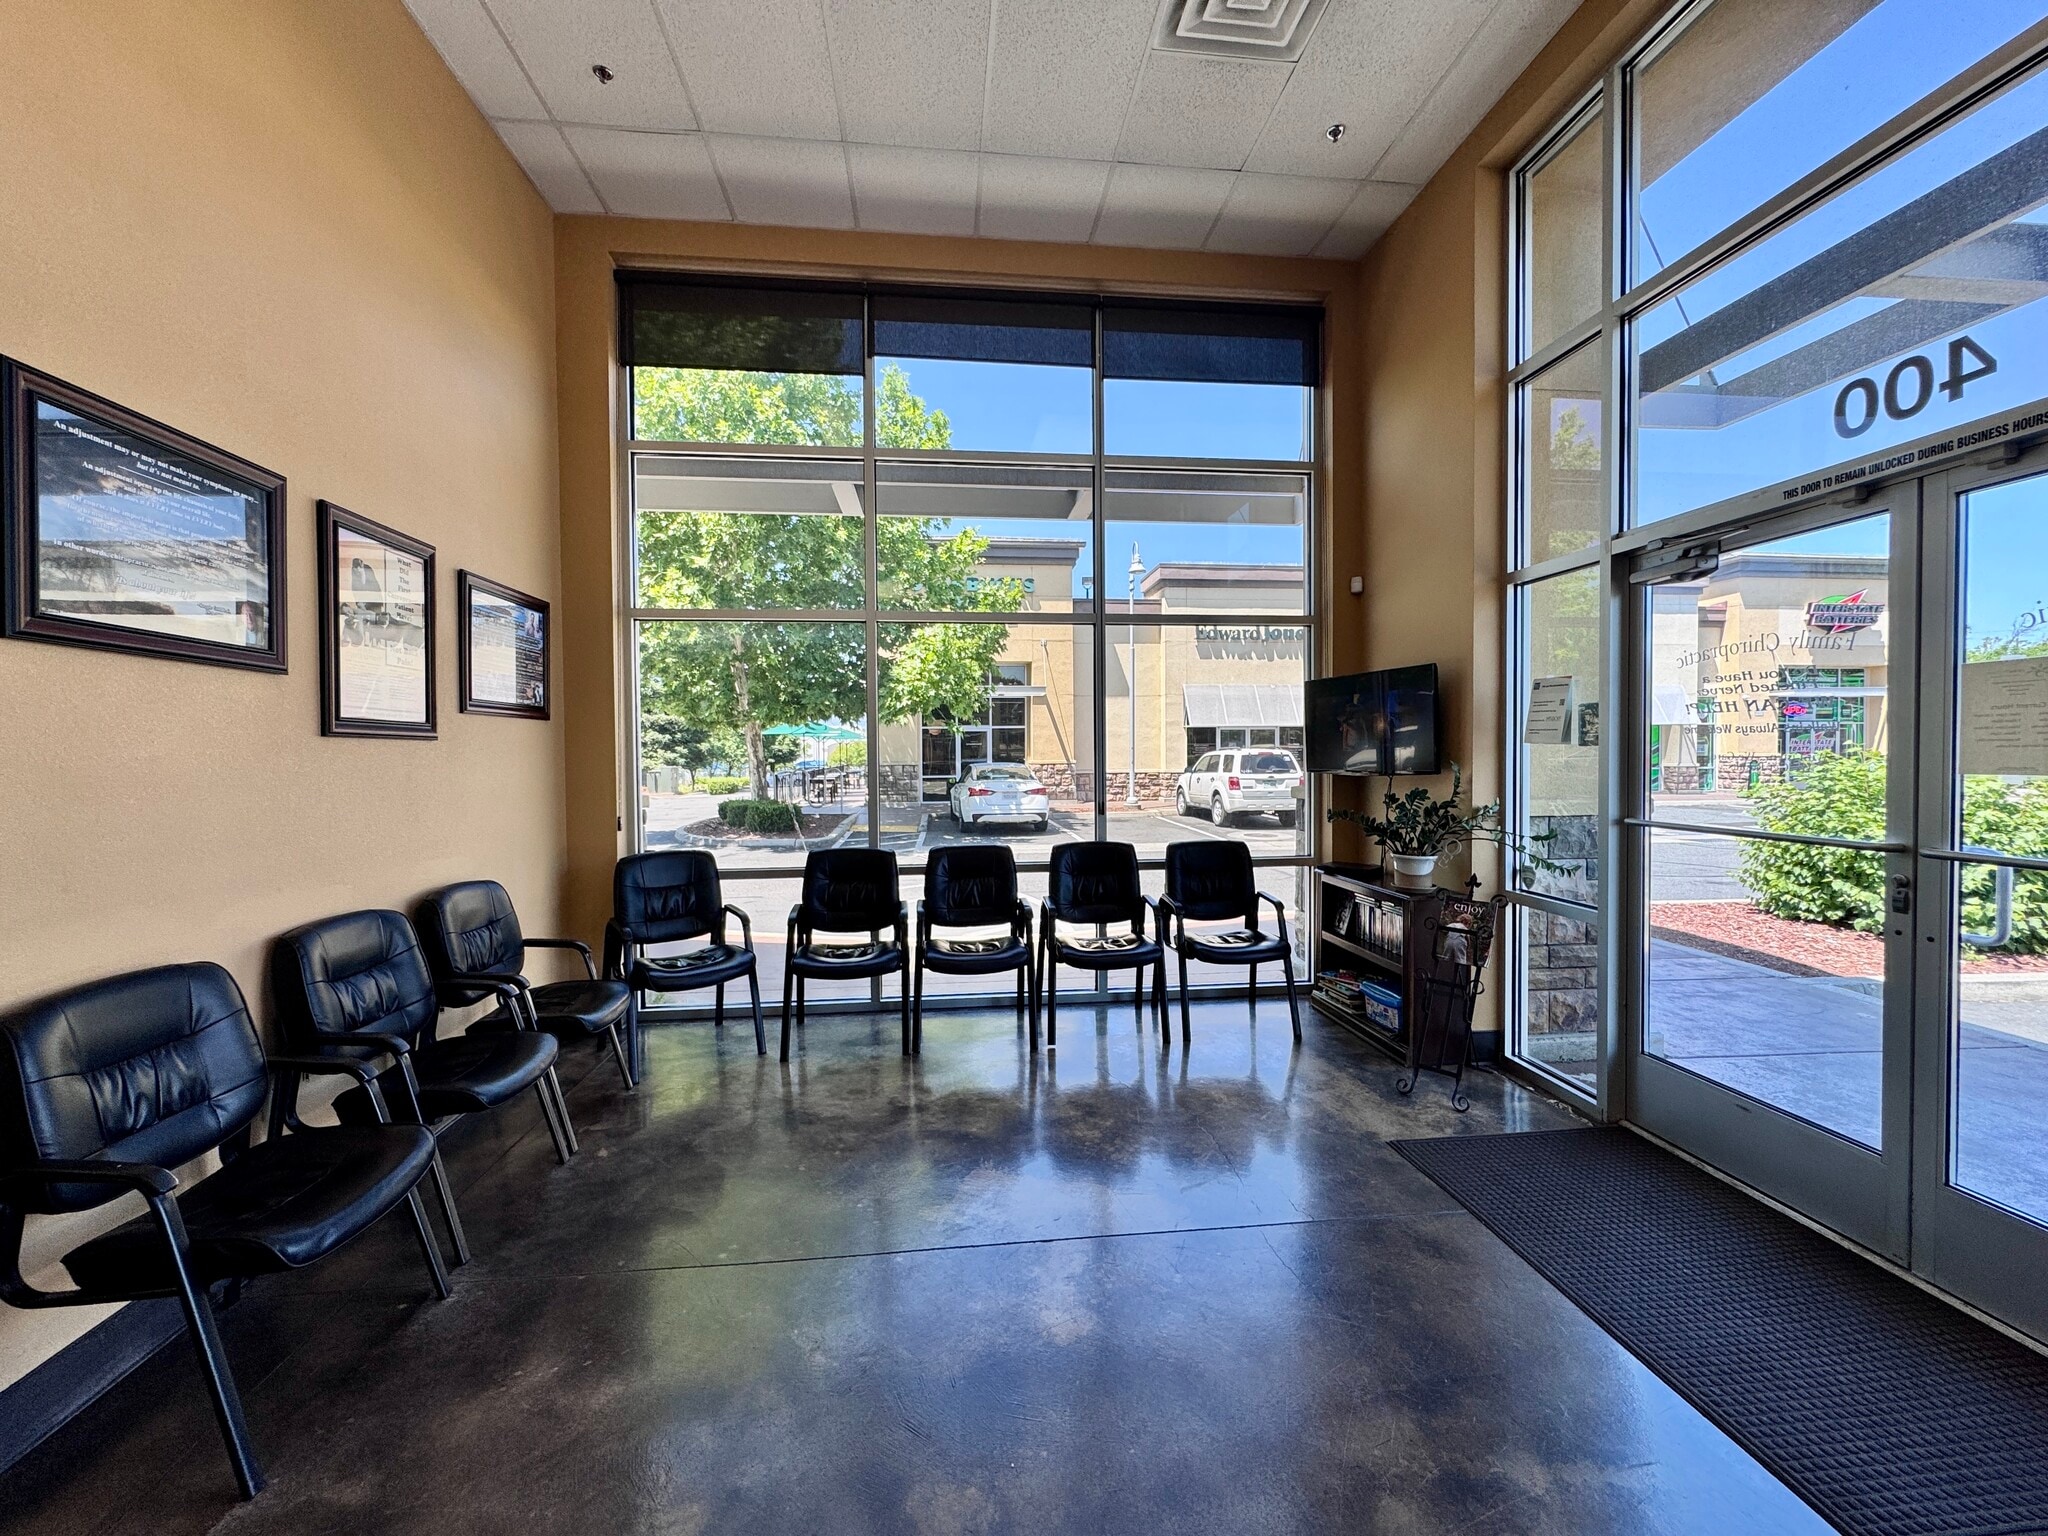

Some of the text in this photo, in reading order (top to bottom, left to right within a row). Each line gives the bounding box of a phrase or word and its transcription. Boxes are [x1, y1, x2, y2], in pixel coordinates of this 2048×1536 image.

[53, 419, 66, 430] An
[68, 426, 112, 447] adjustment
[114, 444, 129, 455] may
[131, 450, 139, 458] or
[140, 454, 155, 465] may
[157, 461, 168, 469] not
[169, 466, 187, 476] make
[187, 471, 202, 480] your
[203, 479, 232, 493] symptoms
[1783, 411, 2048, 500] THIS DOOR TO REMAIN UNLOCKED DURING BUSINESS HOURS
[82, 460, 92, 470] An
[94, 466, 132, 483] adjustment
[153, 486, 161, 494] up
[162, 488, 172, 497] the
[136, 461, 148, 471] but
[148, 465, 159, 475] it's
[172, 477, 191, 487] meant
[192, 482, 200, 490] to.
[63, 541, 83, 551] other
[399, 576, 410, 586] The
[394, 603, 414, 614] Patient
[1813, 604, 1885, 613] INTERSTATE
[1814, 615, 1879, 624] BATTERIES
[1195, 625, 1262, 640] Edward
[1454, 903, 1485, 918] enjoy
